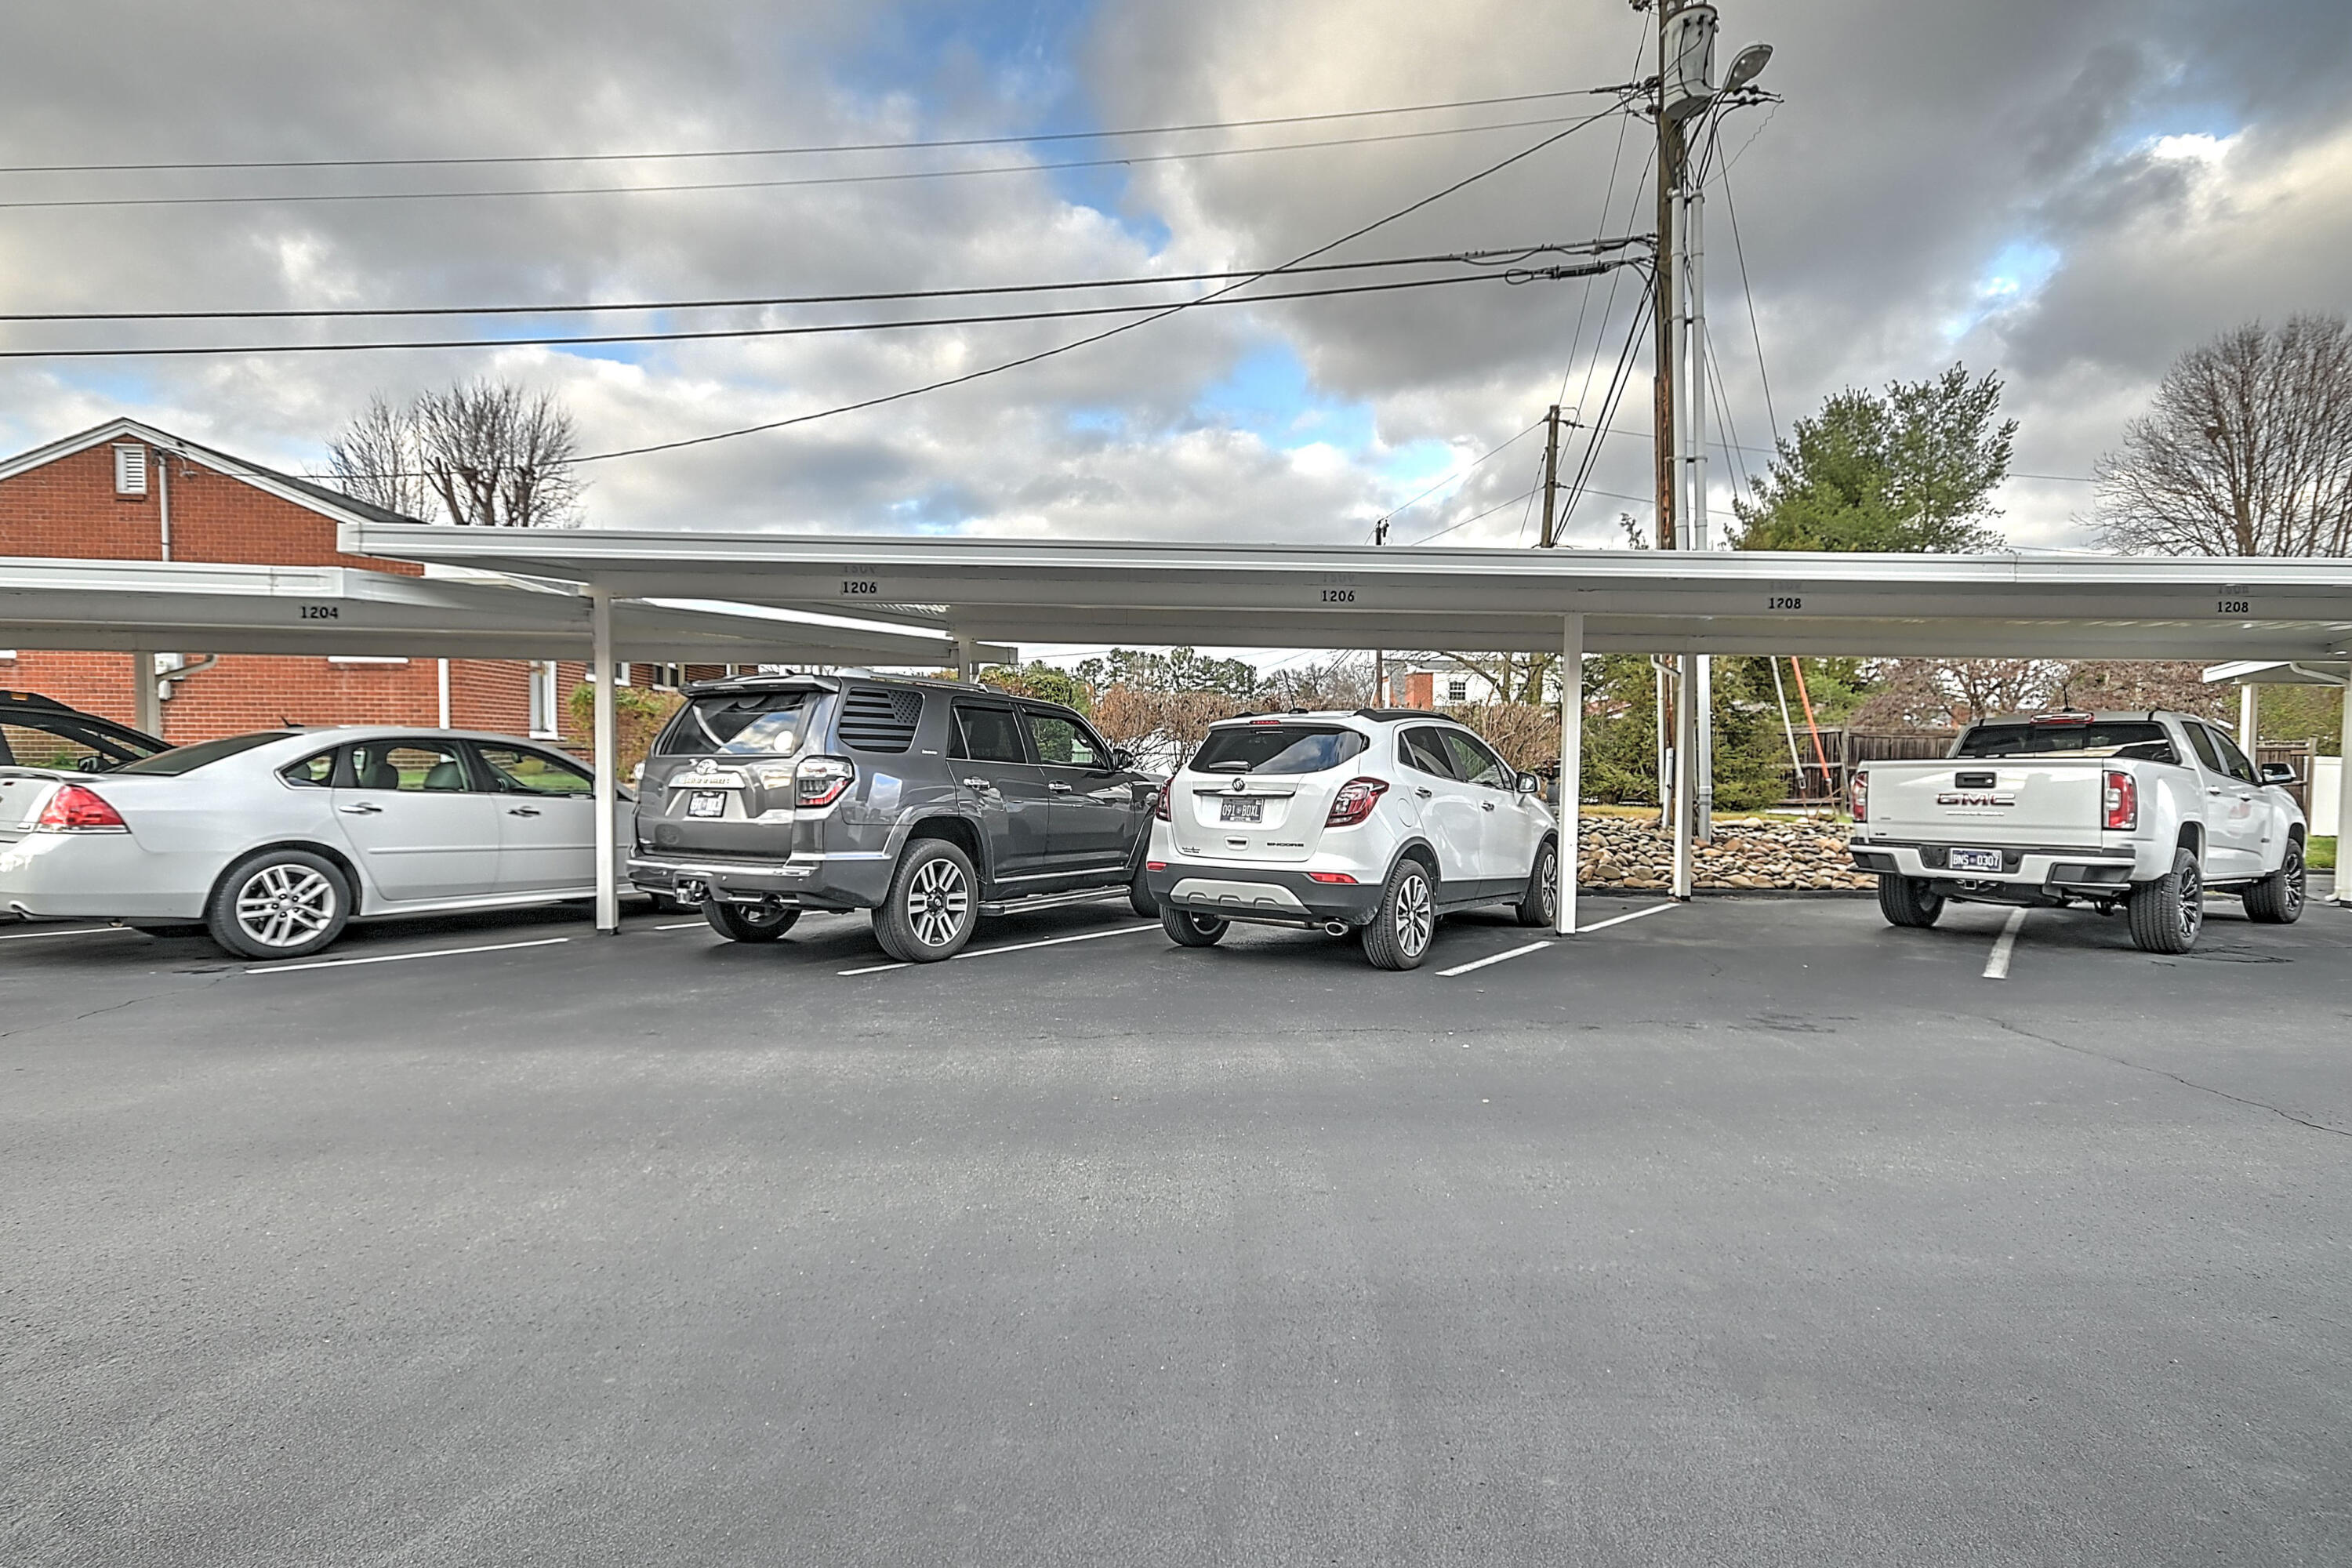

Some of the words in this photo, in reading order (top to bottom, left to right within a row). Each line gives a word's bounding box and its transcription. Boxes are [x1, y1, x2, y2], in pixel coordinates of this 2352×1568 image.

[844, 582, 877, 593] 1206
[1323, 590, 1355, 602] 1206
[1769, 597, 1801, 609] 1208
[2218, 601, 2249, 612] 1208
[301, 606, 338, 619] 1204
[1937, 793, 2015, 806] GMC
[1222, 804, 1235, 816] 091
[1977, 855, 1999, 866] 0307
